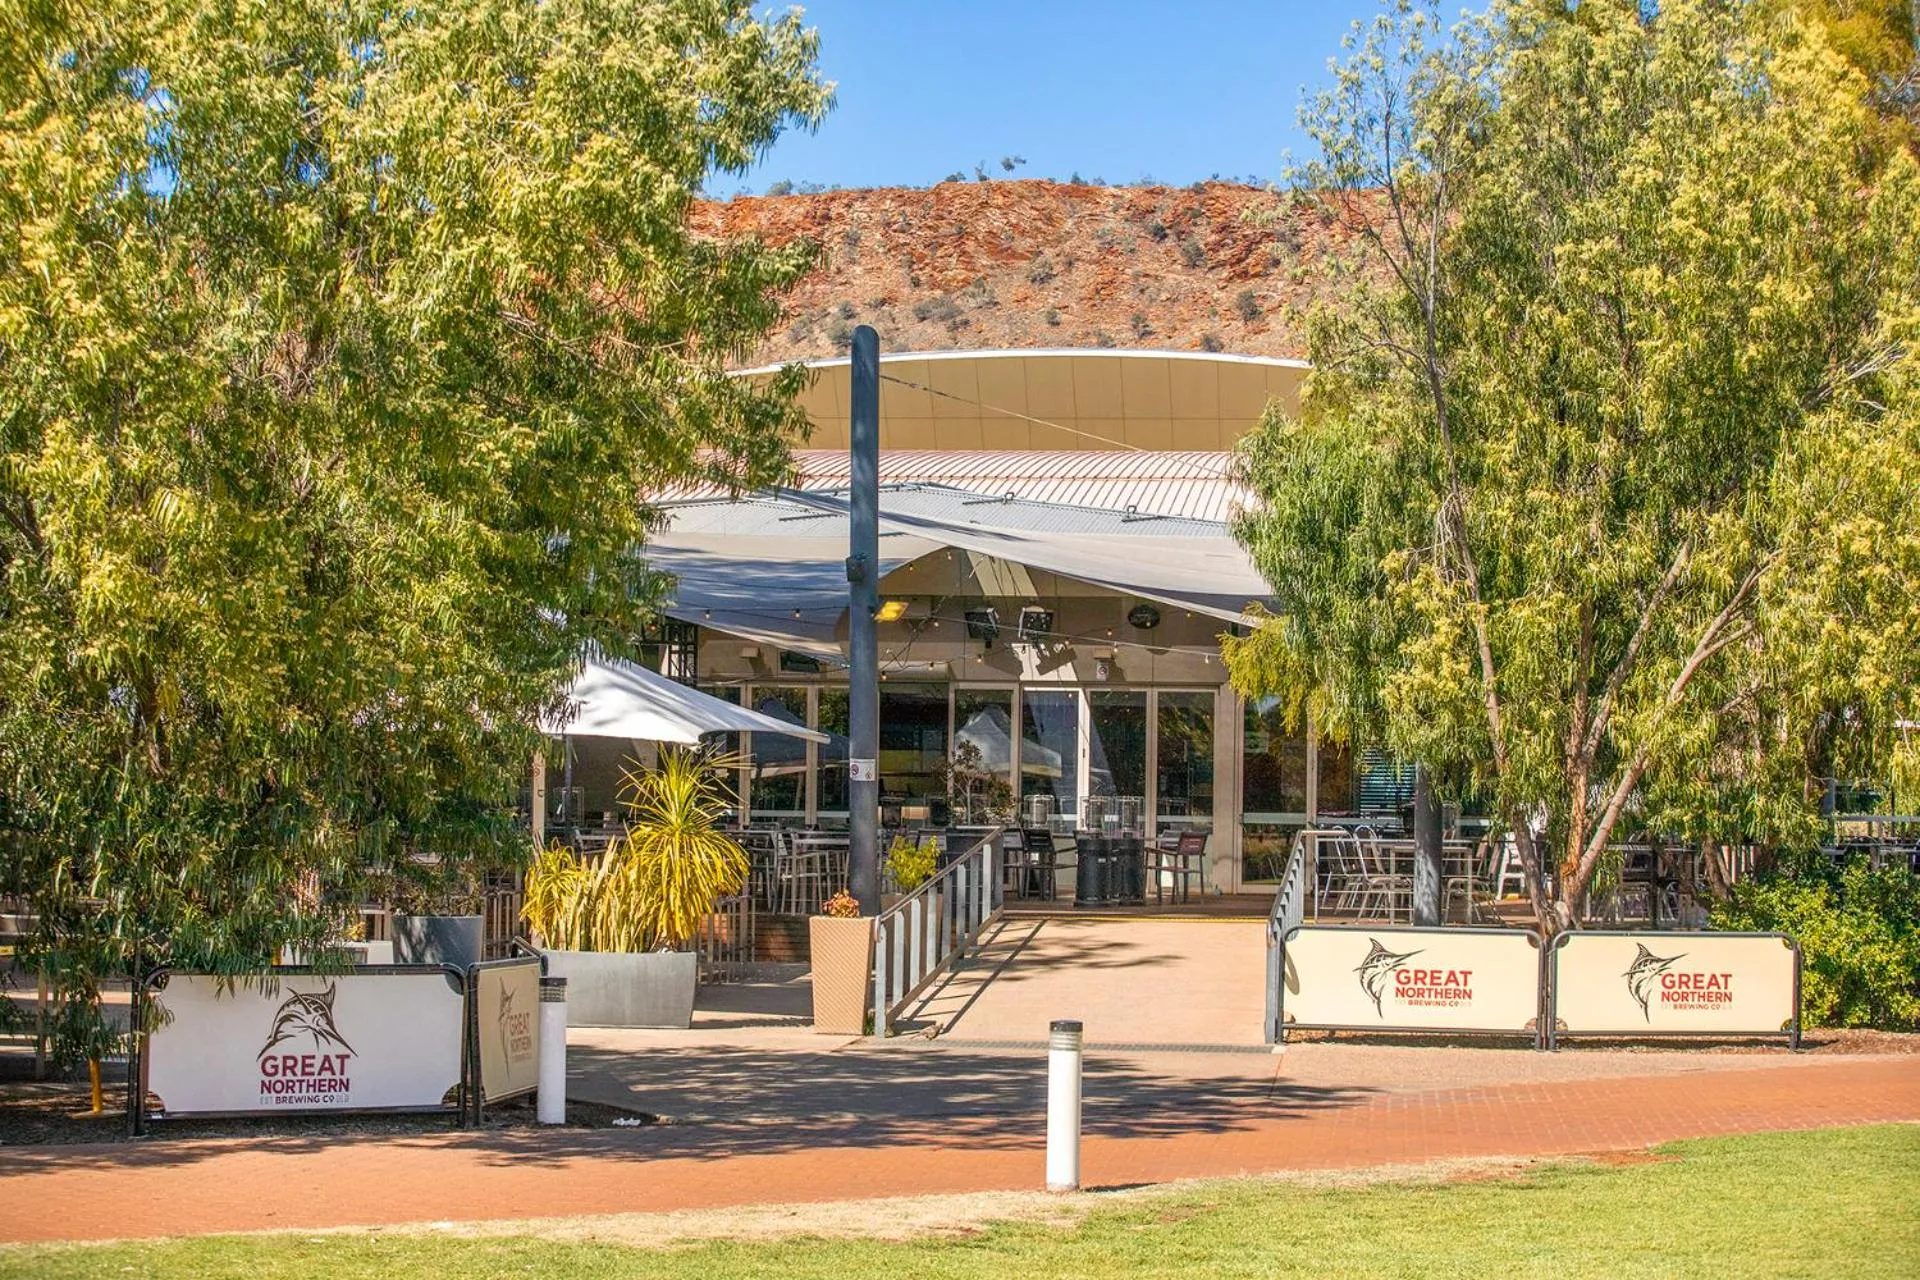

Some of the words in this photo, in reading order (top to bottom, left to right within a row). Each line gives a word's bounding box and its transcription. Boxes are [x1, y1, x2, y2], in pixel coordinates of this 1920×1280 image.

[1395, 969, 1473, 987] GREAT
[1661, 973, 1733, 990] GREAT
[1395, 987, 1473, 1000] NORTHERN
[1661, 991, 1733, 1003] NORTHERN
[1407, 999, 1448, 1007] BREWING
[507, 1012, 531, 1035] GREAT
[260, 1054, 351, 1078] GREAT
[260, 1078, 351, 1095] NORTHERN
[275, 1095, 321, 1105] BREWING
